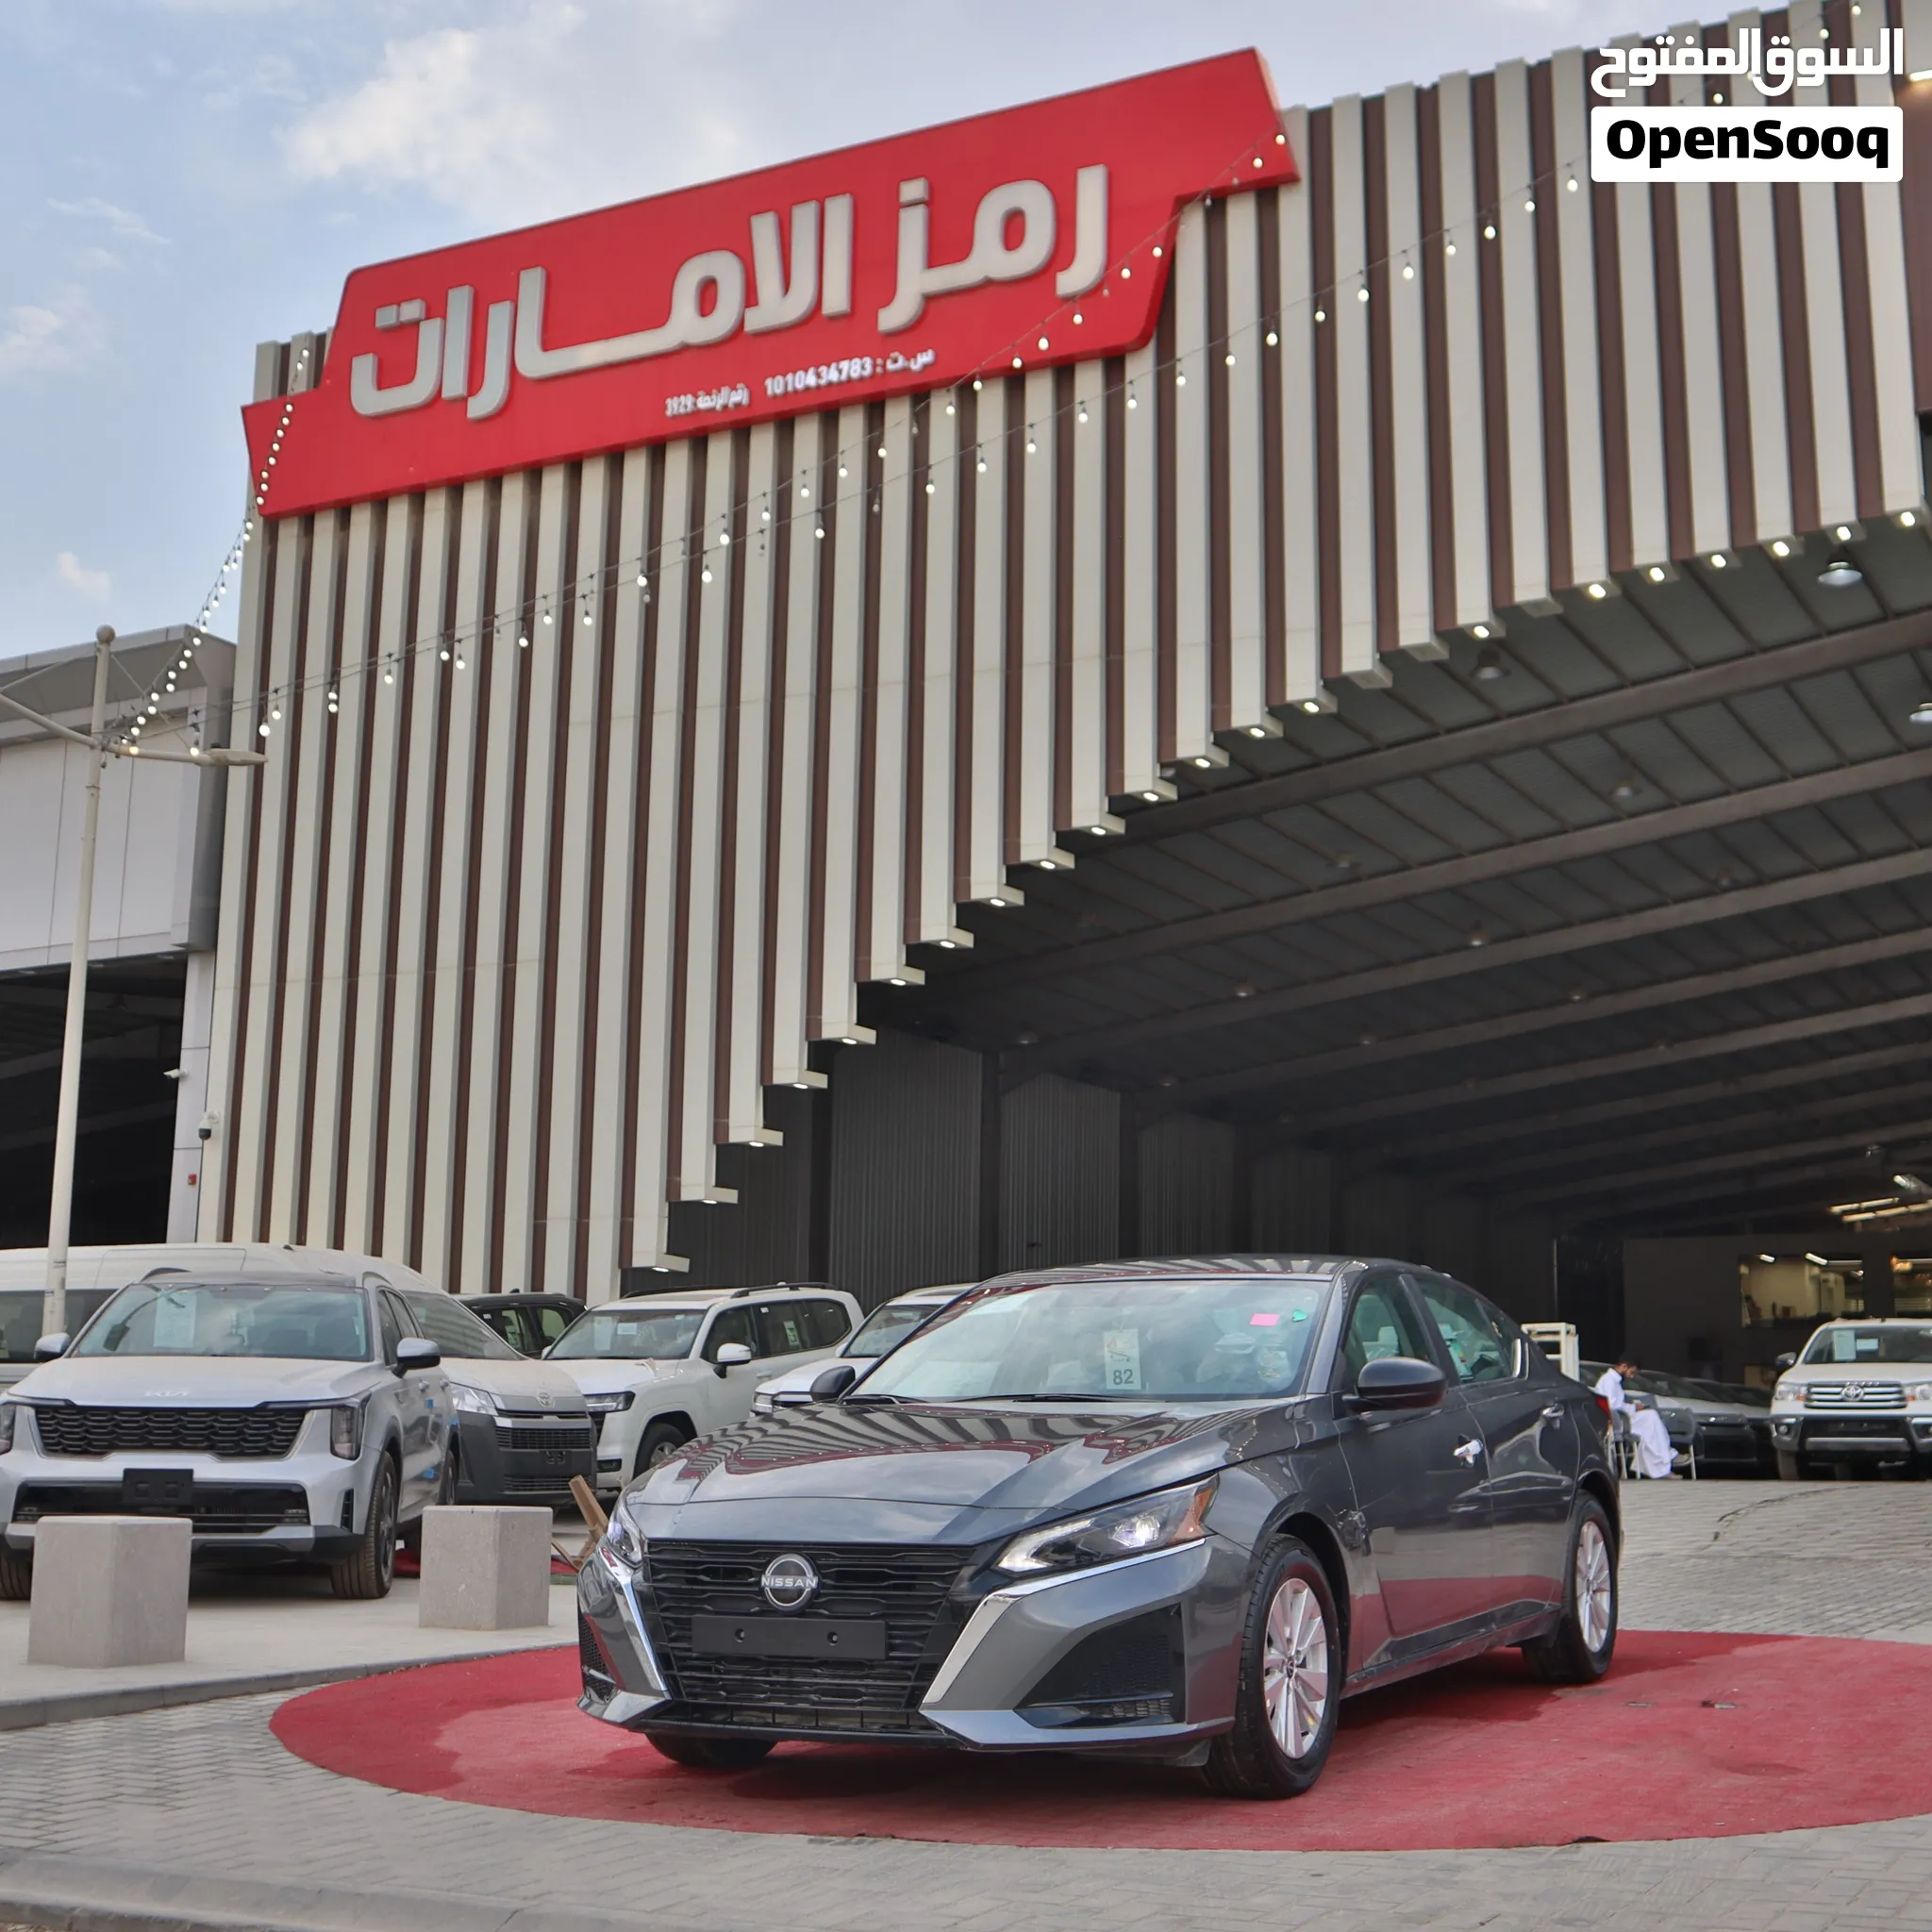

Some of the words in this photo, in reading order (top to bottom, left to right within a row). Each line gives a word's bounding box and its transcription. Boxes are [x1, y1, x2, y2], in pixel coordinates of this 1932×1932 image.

[877, 163, 1109, 335] رمز
[350, 193, 854, 420] الامارات
[764, 356, 874, 397] 1010434783
[1113, 1369, 1134, 1386] 82
[761, 1575, 818, 1588] NISSAN
